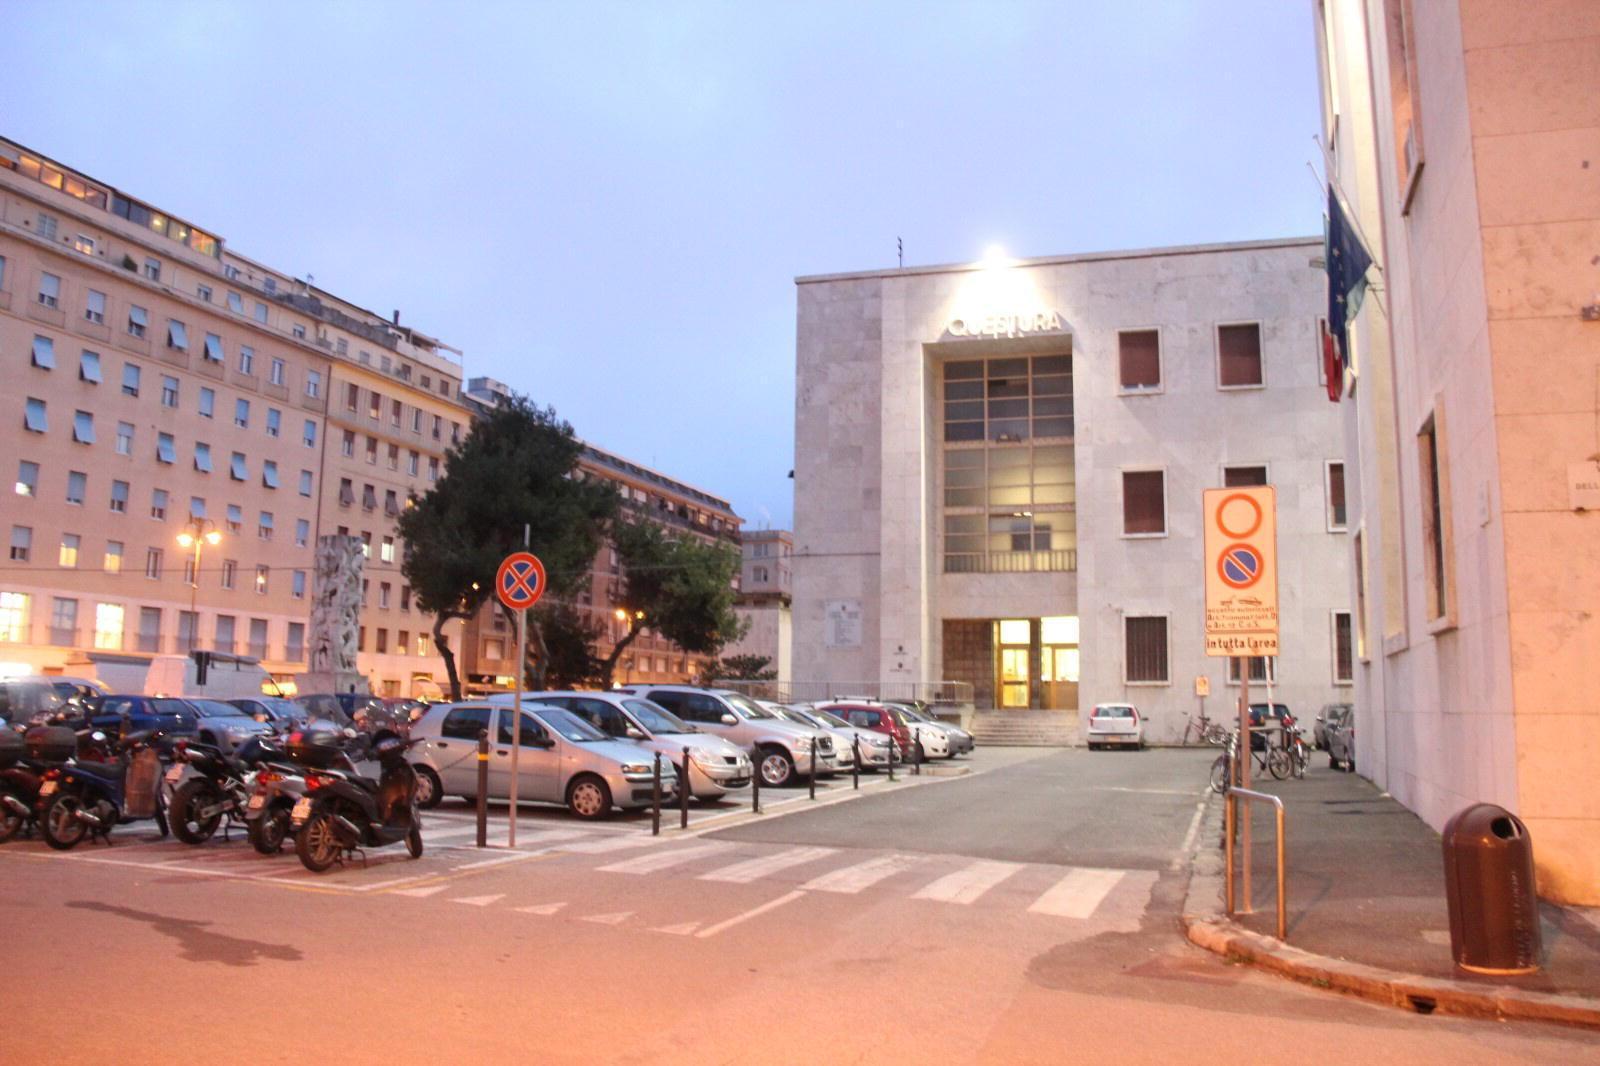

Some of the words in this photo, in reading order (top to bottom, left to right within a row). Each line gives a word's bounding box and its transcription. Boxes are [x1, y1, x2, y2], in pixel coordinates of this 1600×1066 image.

[948, 311, 1062, 337] QUESTURA
[1206, 638, 1217, 649] in
[1218, 637, 1245, 649] tutta
